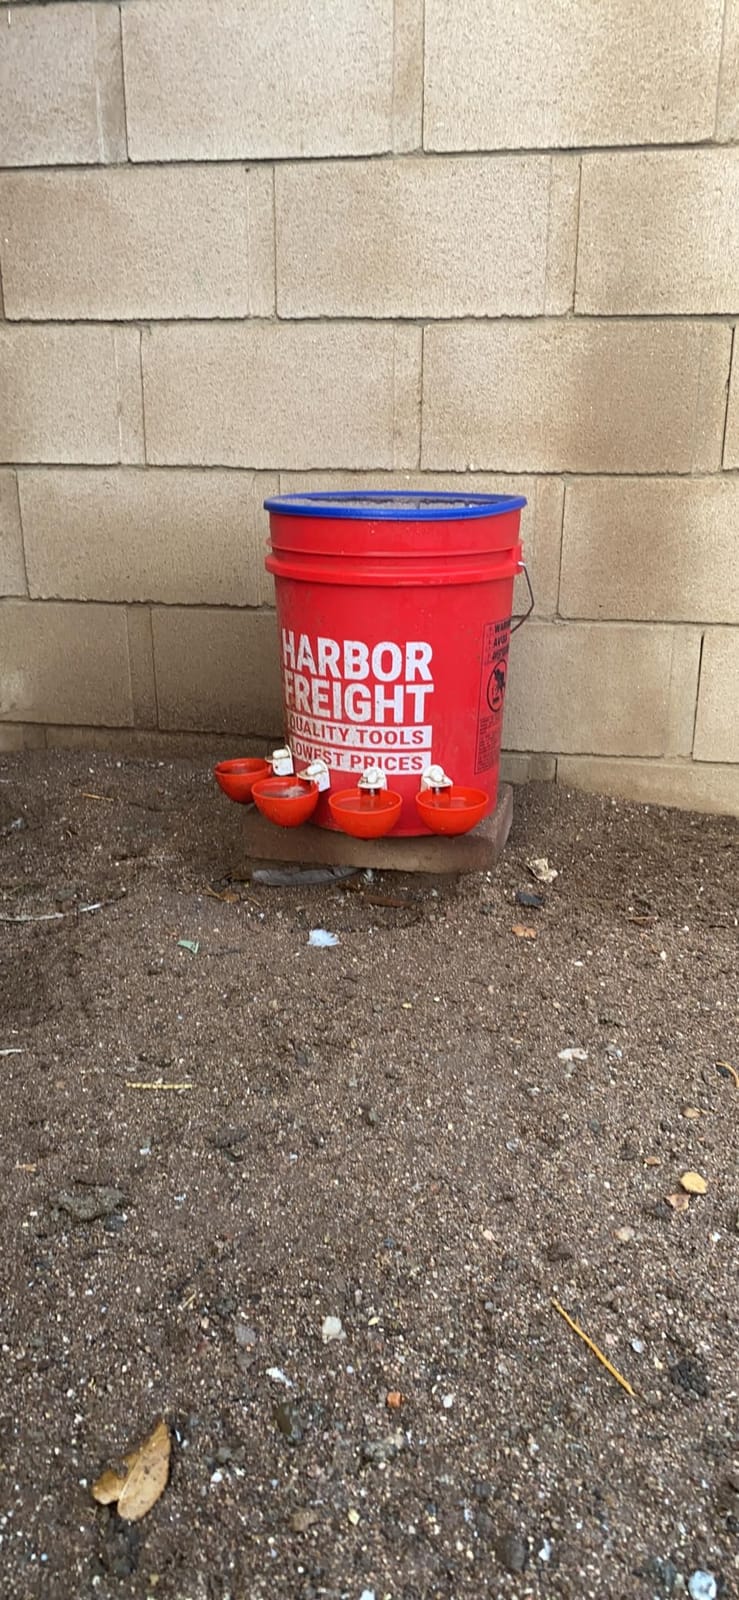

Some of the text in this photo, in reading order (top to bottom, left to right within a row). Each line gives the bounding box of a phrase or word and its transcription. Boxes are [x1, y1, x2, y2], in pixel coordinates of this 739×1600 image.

[282, 628, 433, 682] HARBOR
[284, 669, 435, 723] FREIGHT
[290, 714, 424, 745] QUALITY TOOLS
[290, 738, 423, 771] LOWEST PRICES
